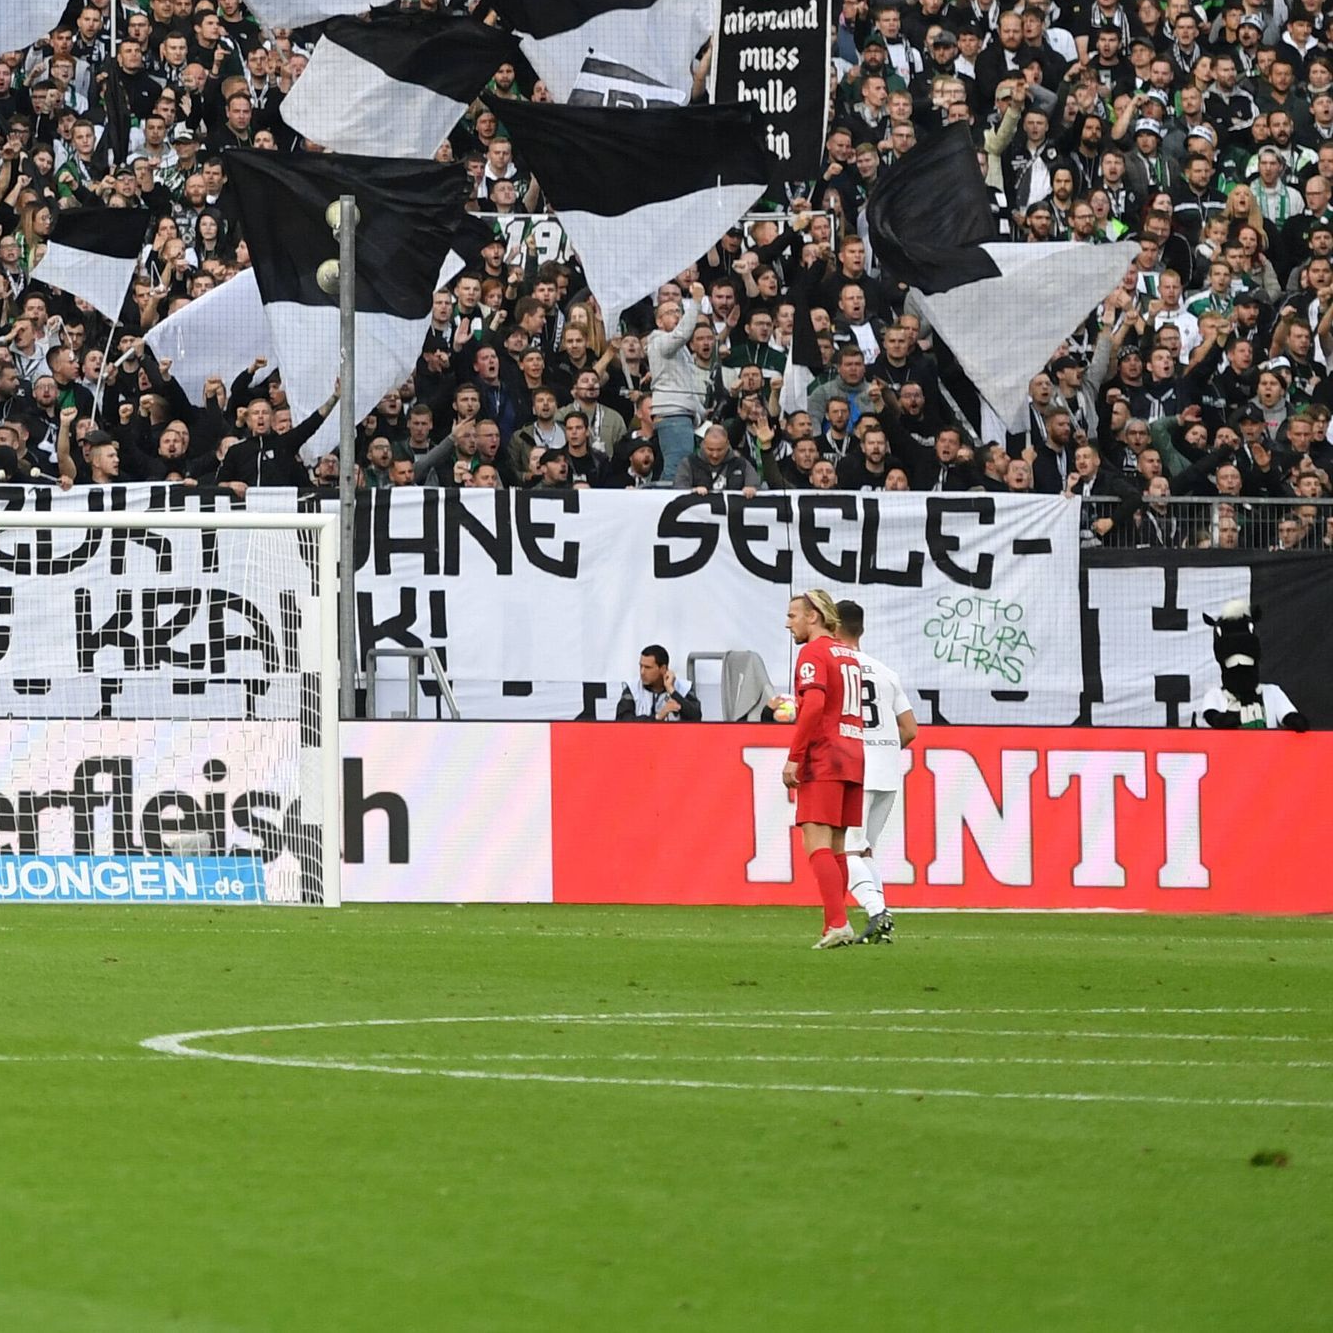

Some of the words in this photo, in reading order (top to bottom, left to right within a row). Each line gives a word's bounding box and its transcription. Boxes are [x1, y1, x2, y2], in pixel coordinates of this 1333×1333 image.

[739, 46, 799, 72] muss
[766, 124, 791, 160] in
[937, 596, 1023, 622] SOTTO
[924, 618, 1036, 657] CULTURA
[933, 640, 1025, 684] ULTRAS
[840, 663, 861, 718] 10
